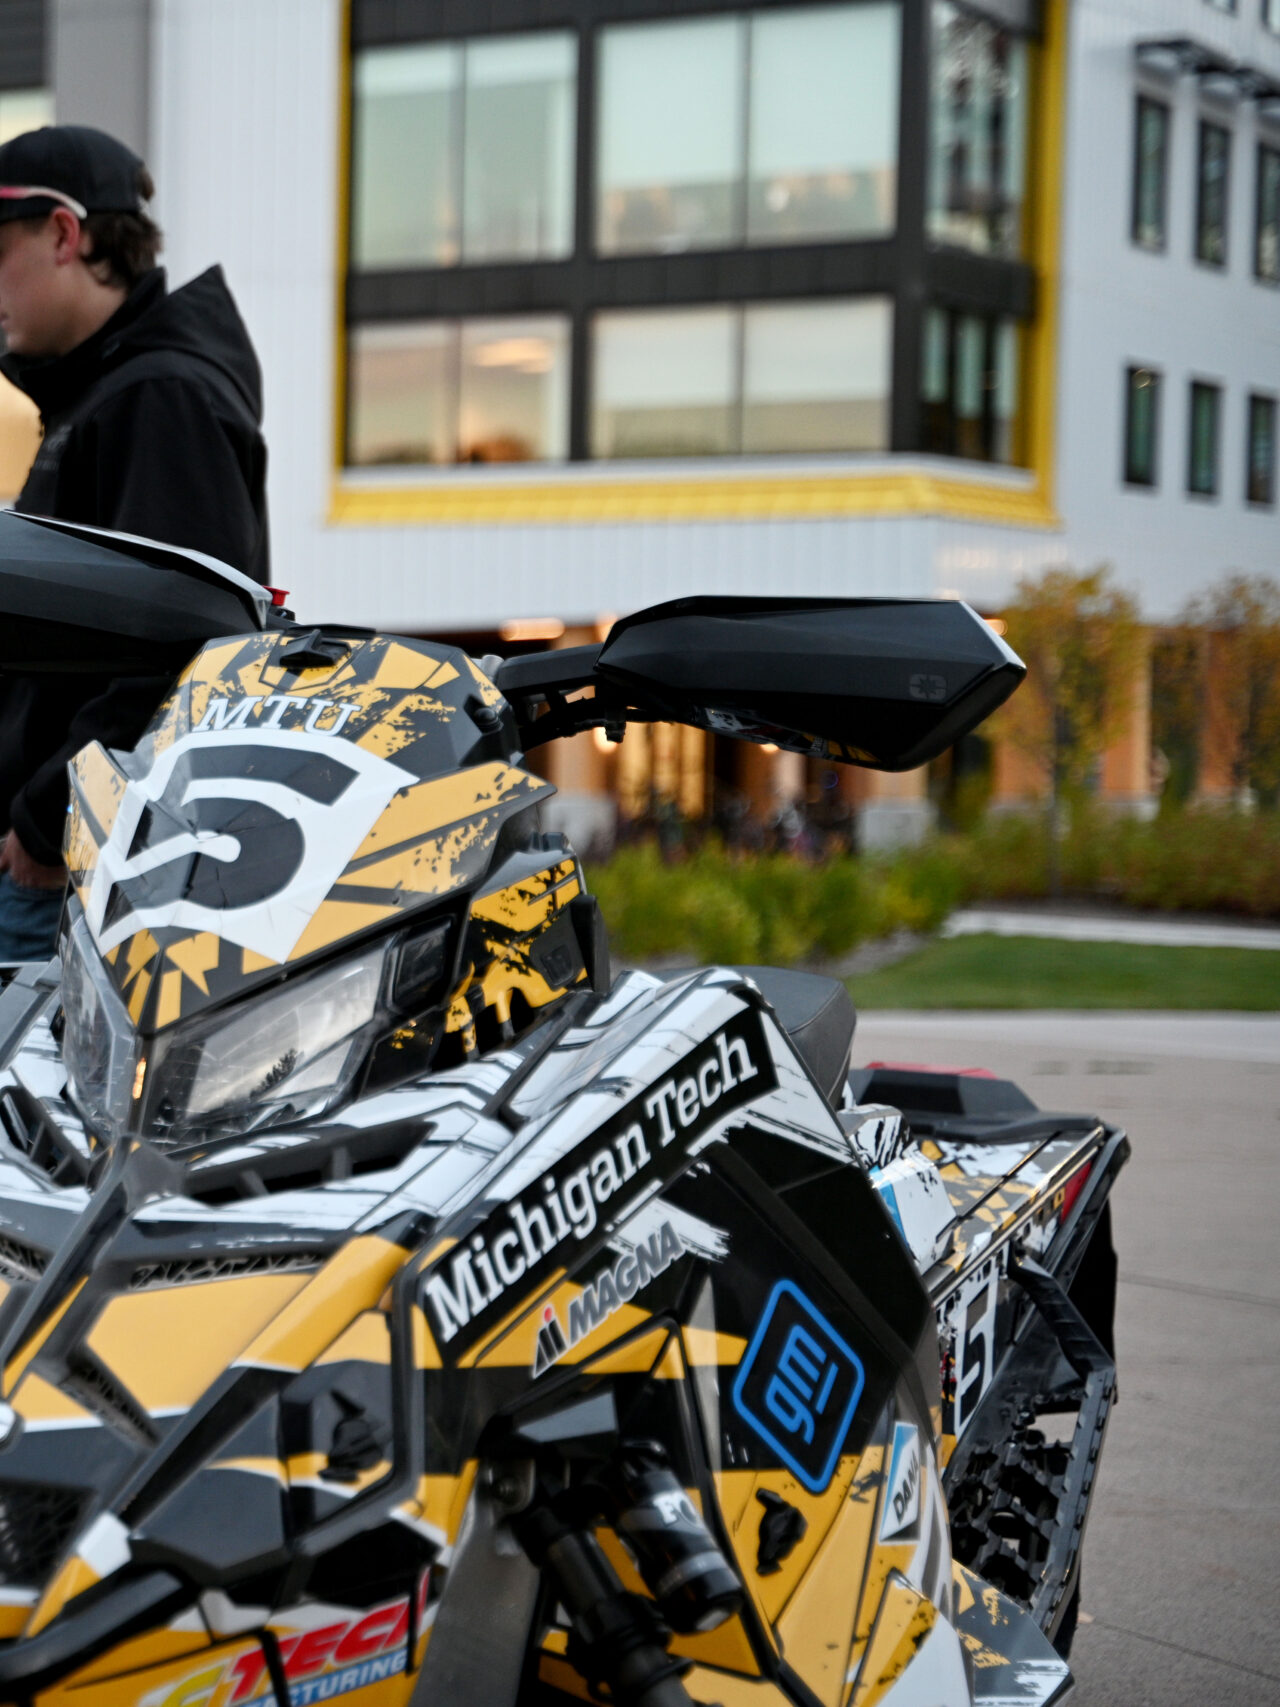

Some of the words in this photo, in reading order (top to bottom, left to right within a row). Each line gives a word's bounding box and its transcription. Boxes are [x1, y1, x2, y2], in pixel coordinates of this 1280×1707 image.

[192, 695, 362, 737] MTU
[99, 730, 419, 964] 5
[425, 1123, 651, 1343] Michigan
[645, 1032, 758, 1148] Tech
[568, 1222, 687, 1347] MAGNA
[765, 1324, 828, 1446] gm
